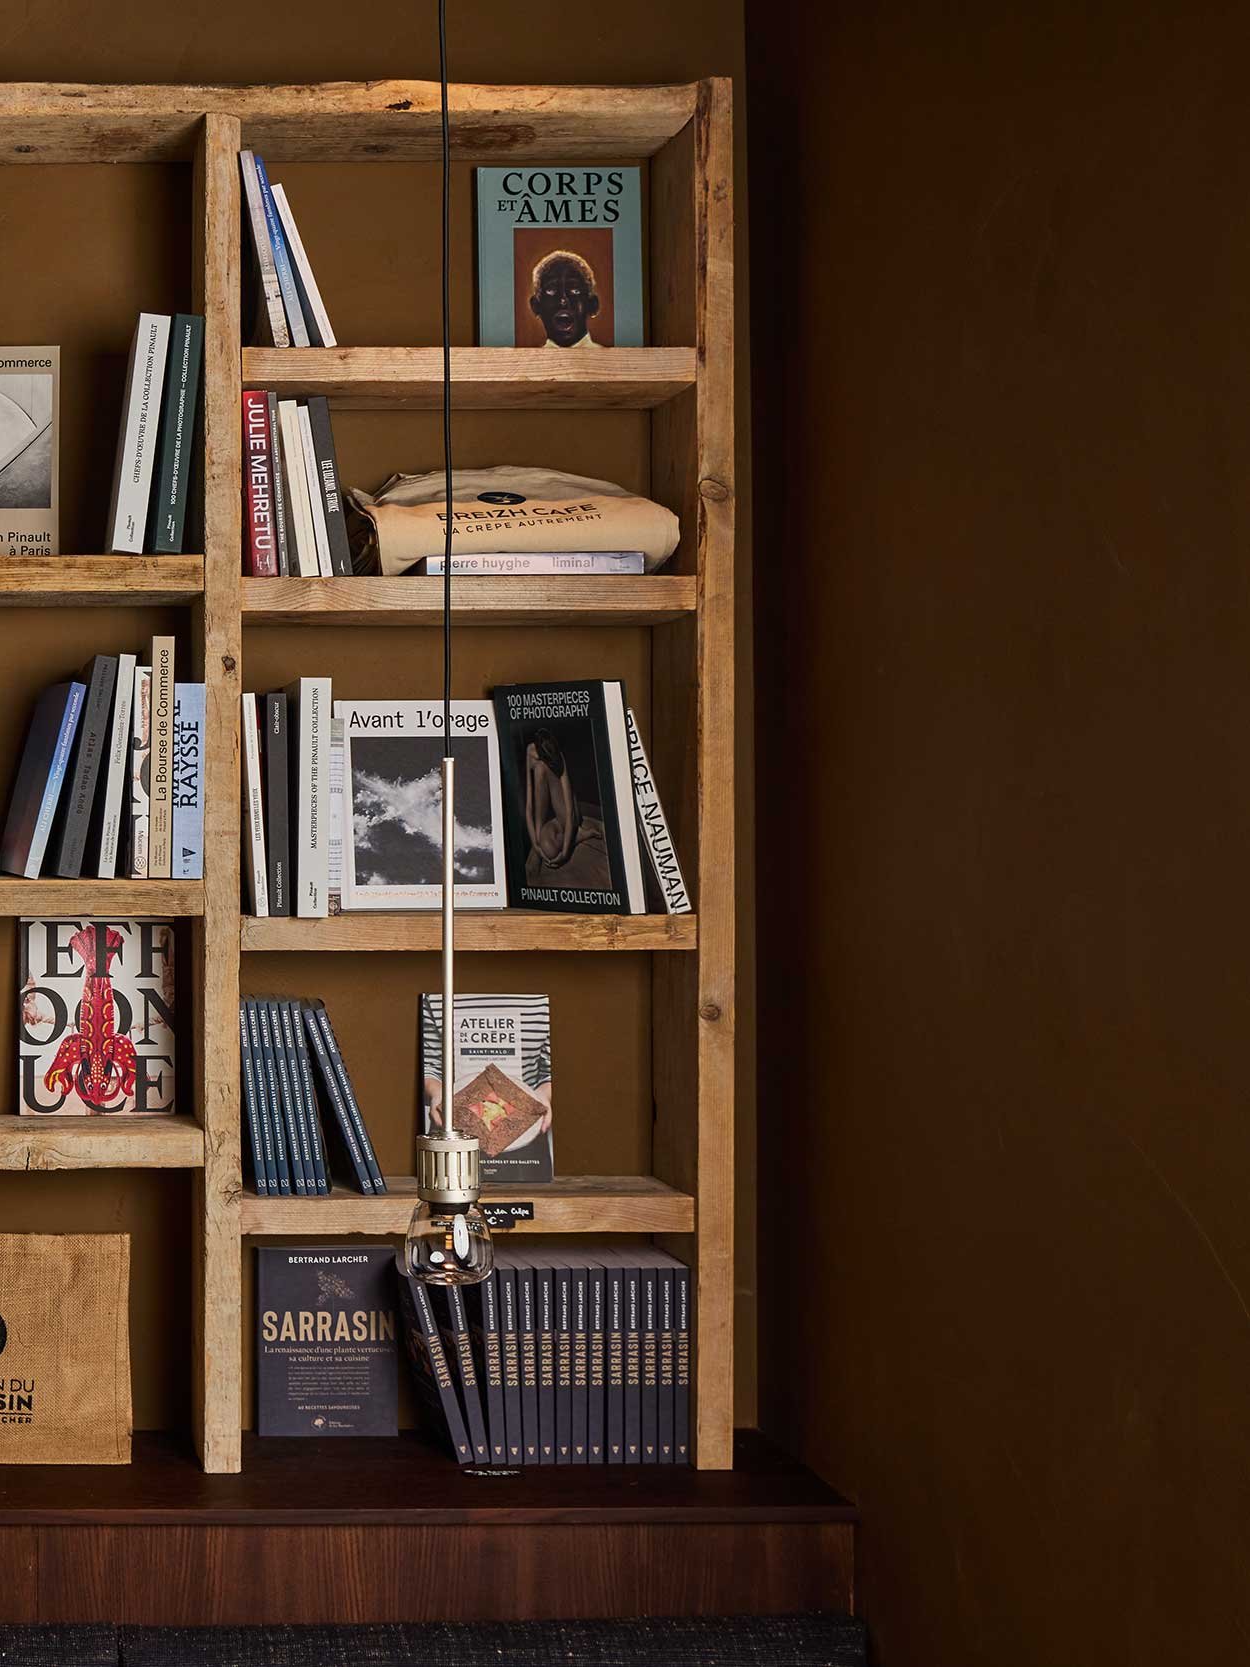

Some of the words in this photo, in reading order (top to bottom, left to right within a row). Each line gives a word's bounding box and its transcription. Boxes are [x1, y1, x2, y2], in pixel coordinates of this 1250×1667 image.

[503, 172, 624, 196] CORPS
[497, 200, 518, 212] ET
[515, 193, 620, 223] ÂMES
[248, 398, 266, 450] JULIE
[251, 455, 271, 549] MEHRETU
[436, 508, 527, 521] BREIZH
[532, 504, 598, 516] CAFE
[443, 528, 460, 536] LA
[519, 513, 602, 527] AUTREMENT
[8, 532, 51, 542] Pinault
[10, 546, 16, 556] à
[21, 546, 50, 556] Paris
[440, 558, 478, 571] perre
[482, 558, 530, 570] huyghe
[552, 557, 594, 568] liminal
[157, 650, 169, 717] Commerce
[507, 694, 522, 707] 100
[523, 691, 590, 706] MASTERPIECES
[350, 711, 404, 728] Avant
[510, 707, 522, 720] OF
[523, 705, 589, 720] PHOTOGRAPHY
[156, 721, 168, 736] de
[156, 741, 168, 783] Bourse
[180, 721, 198, 808] RAYSSE
[156, 786, 167, 801] La
[642, 803, 688, 910] NAUMAN
[521, 888, 558, 902] PINAULT
[560, 890, 621, 906] COLLECTION
[460, 1018, 514, 1029] ATELIER
[288, 1256, 330, 1264] BERTRAND
[262, 1311, 394, 1341] SARRASIN
[264, 1346, 274, 1354] La
[275, 1346, 313, 1354] renaissance
[314, 1346, 333, 1354] d'une
[334, 1346, 356, 1355] plante
[299, 1354, 324, 1362] culture
[488, 1332, 500, 1386] SARRASIN
[576, 1332, 586, 1386] SARRASIN
[679, 1332, 688, 1386] SARRASIN
[430, 1334, 450, 1388] SARRASIN
[10, 1378, 34, 1392] DU
